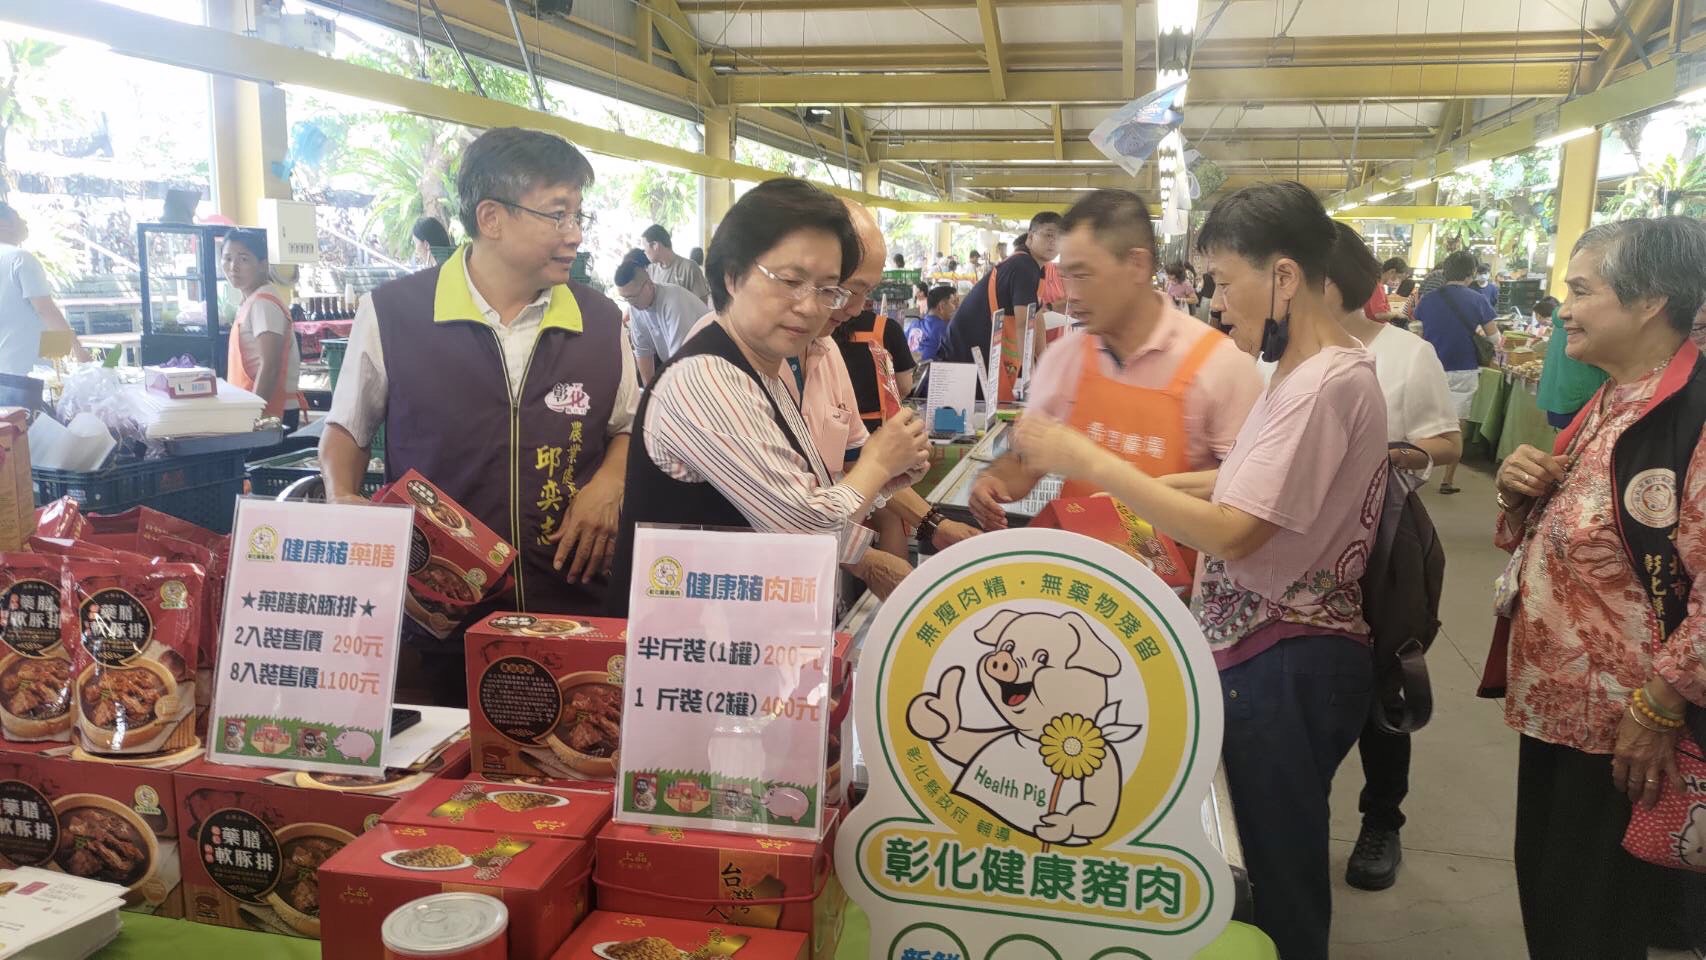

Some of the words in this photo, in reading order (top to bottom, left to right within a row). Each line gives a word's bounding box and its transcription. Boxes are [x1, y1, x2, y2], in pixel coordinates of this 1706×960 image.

[281, 537, 396, 568] 健康豬藥膳
[915, 575, 1008, 647] 無瘦肉精
[1040, 573, 1162, 662] 無藥物殘留
[234, 626, 324, 653] 2入裝售價
[332, 634, 384, 658] 290元
[974, 765, 1019, 799] Health
[1023, 783, 1047, 807] Pig
[221, 826, 262, 849] 藥膳
[214, 847, 274, 871] 軟豚排
[885, 838, 1181, 914] 彰化健康豬肉
